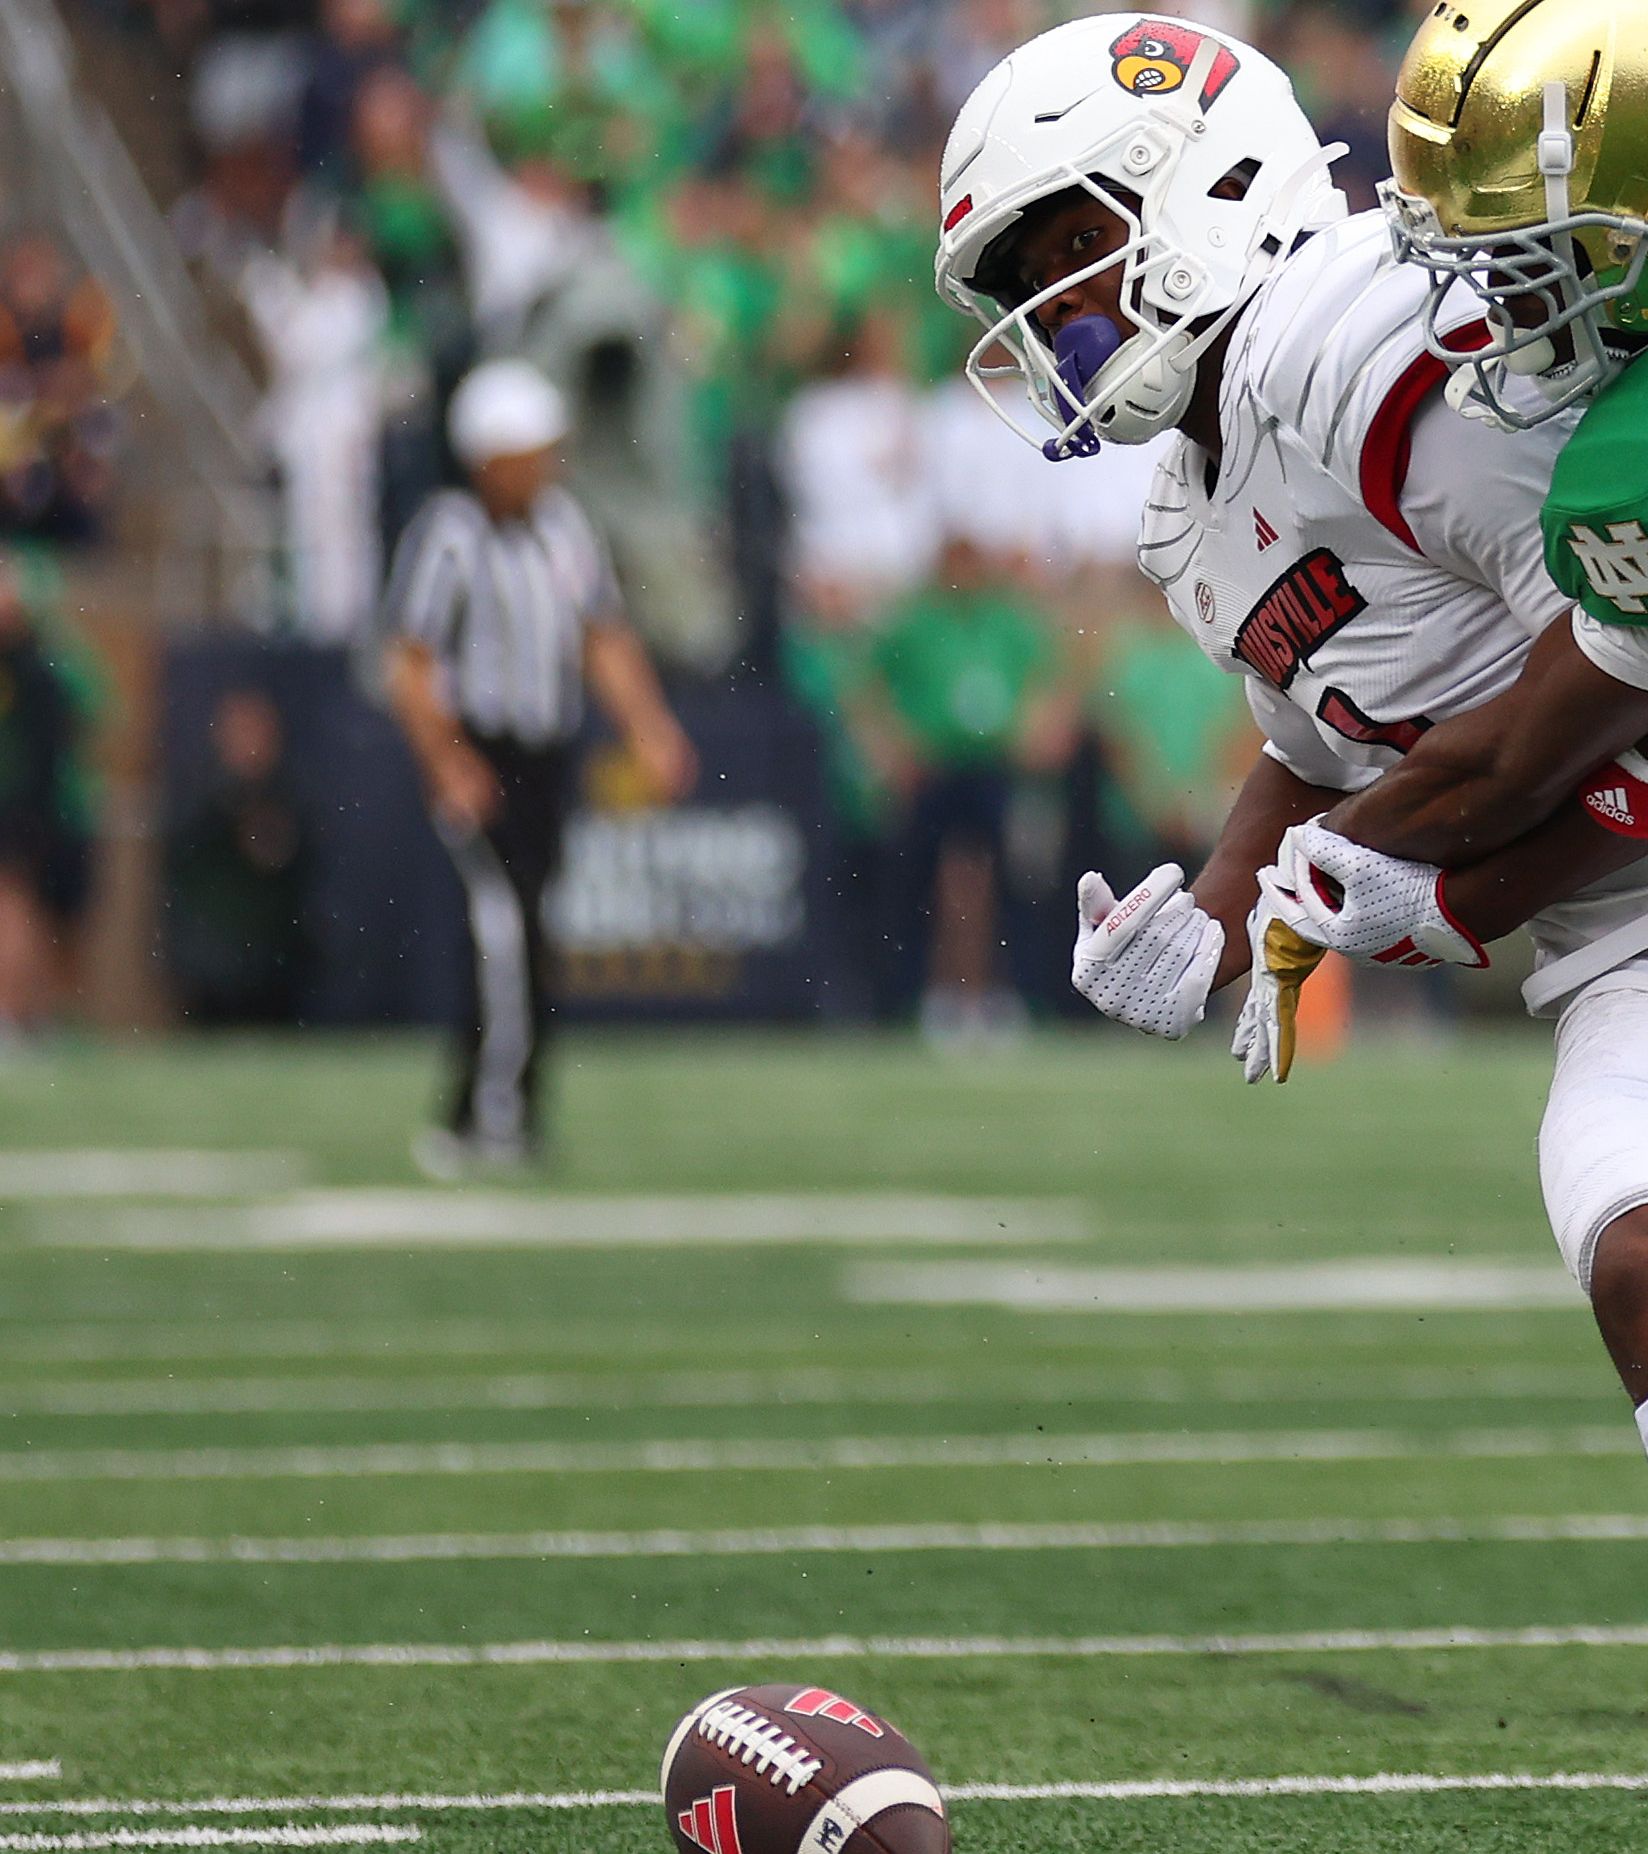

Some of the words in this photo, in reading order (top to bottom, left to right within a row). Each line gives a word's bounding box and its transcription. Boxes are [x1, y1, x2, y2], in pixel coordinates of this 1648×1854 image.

[1233, 547, 1368, 692] UISVILLE
[1586, 794, 1635, 826] adidas
[1106, 887, 1152, 937] ADIZERO
